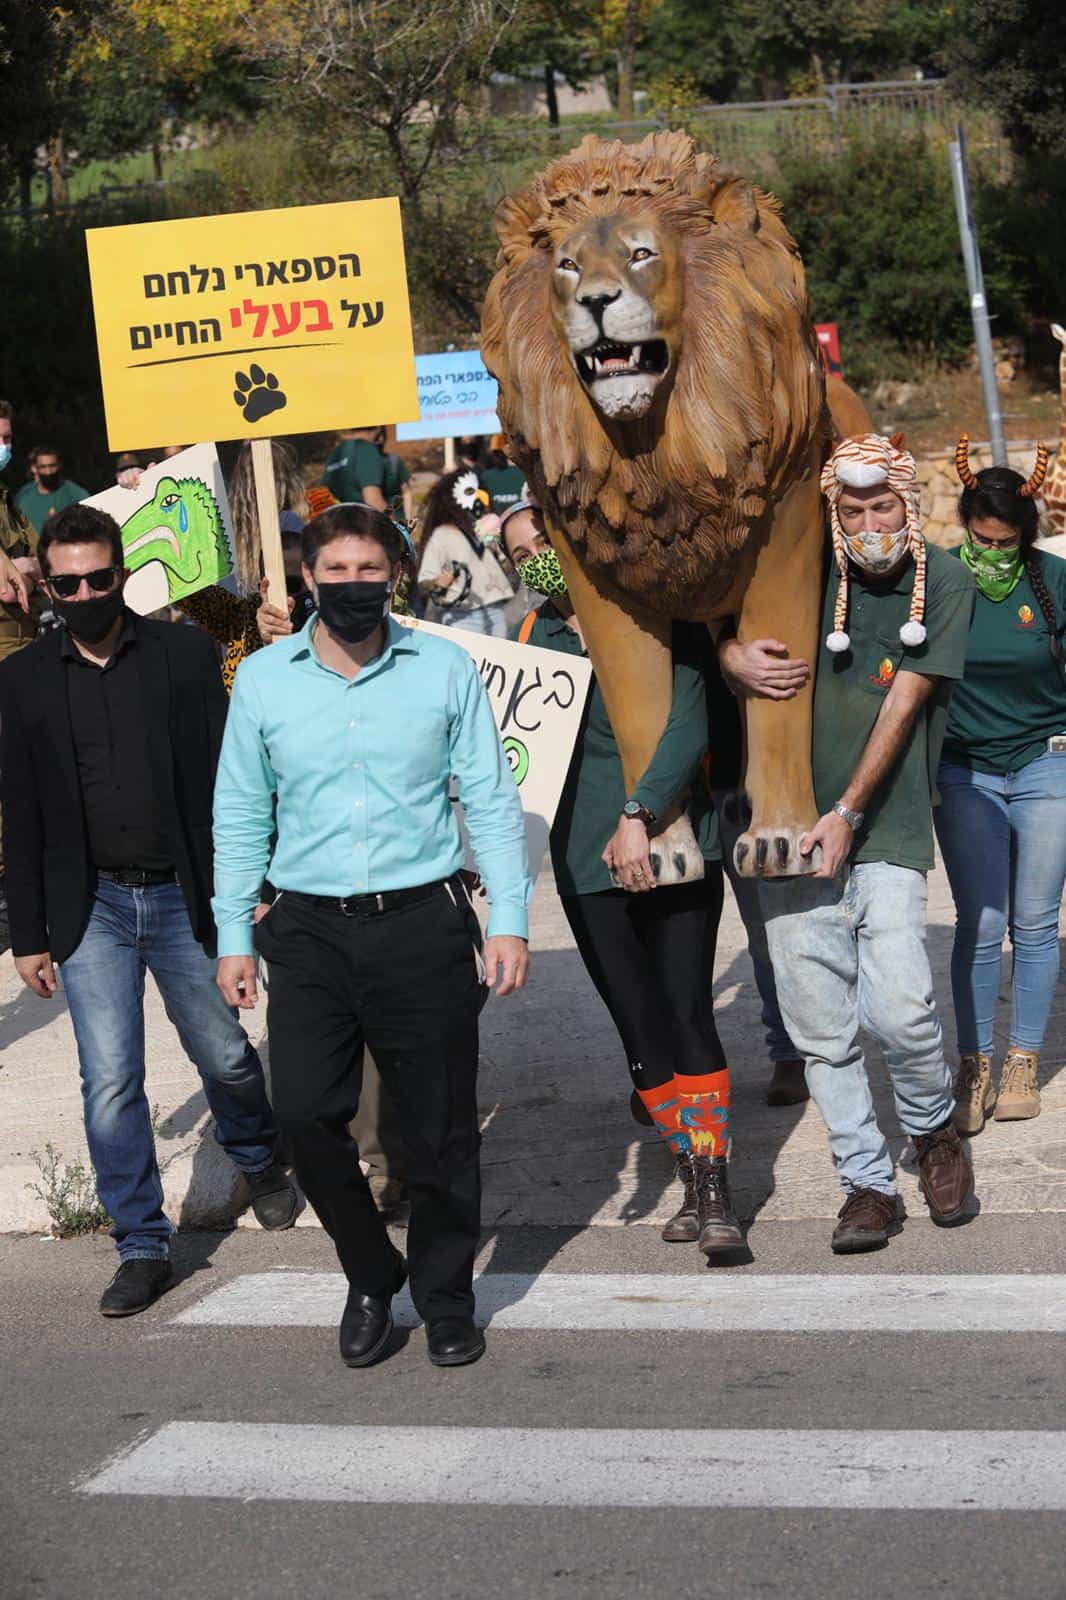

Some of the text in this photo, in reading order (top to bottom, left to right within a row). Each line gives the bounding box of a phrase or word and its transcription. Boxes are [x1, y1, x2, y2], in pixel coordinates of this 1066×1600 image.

[143, 253, 362, 299] הספארי נלחם
[129, 299, 384, 350] על בעלי החיים
